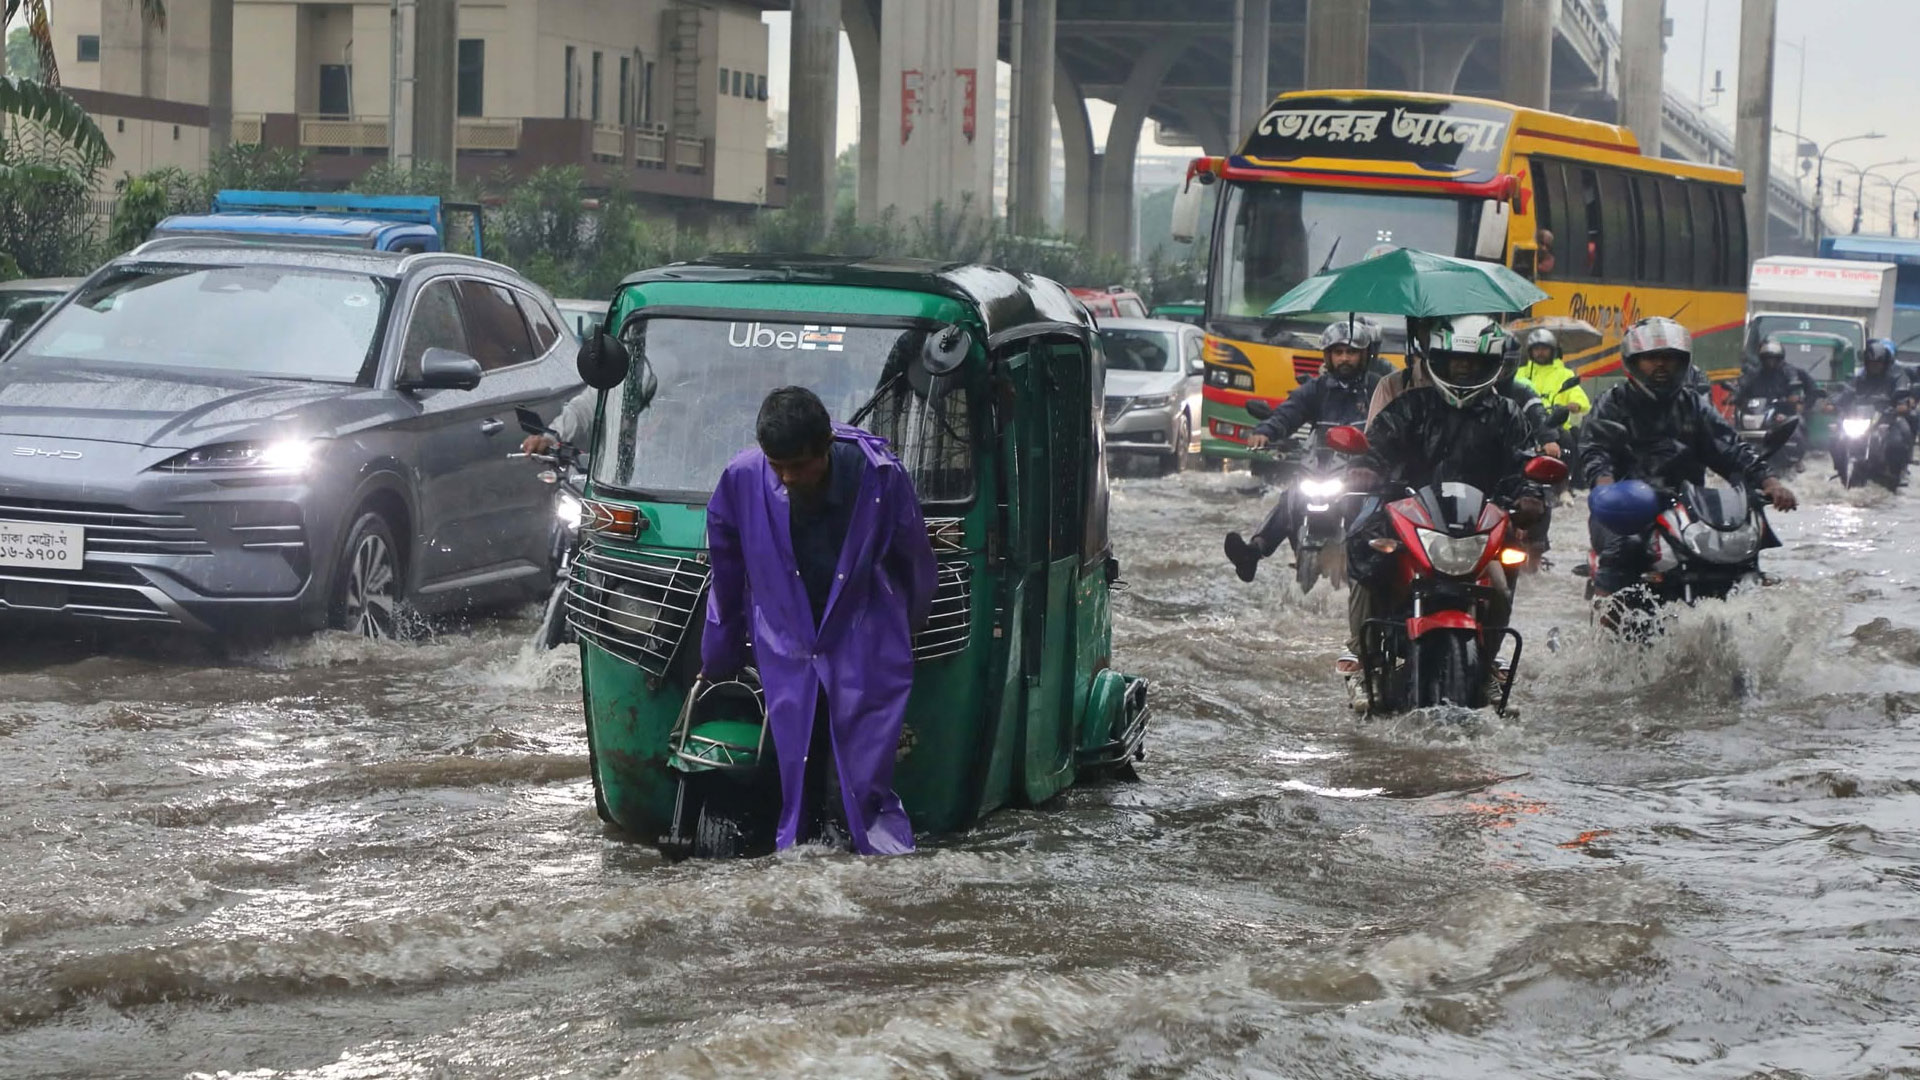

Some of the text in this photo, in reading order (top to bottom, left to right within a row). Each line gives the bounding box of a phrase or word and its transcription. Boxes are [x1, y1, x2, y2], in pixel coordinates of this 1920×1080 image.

[1258, 107, 1504, 153] ভোরের আলো
[728, 321, 811, 350] Uber
[13, 446, 83, 460] BYD
[1, 533, 23, 545] ঢাকা
[0, 546, 67, 561] ১৬-৯৭০০
